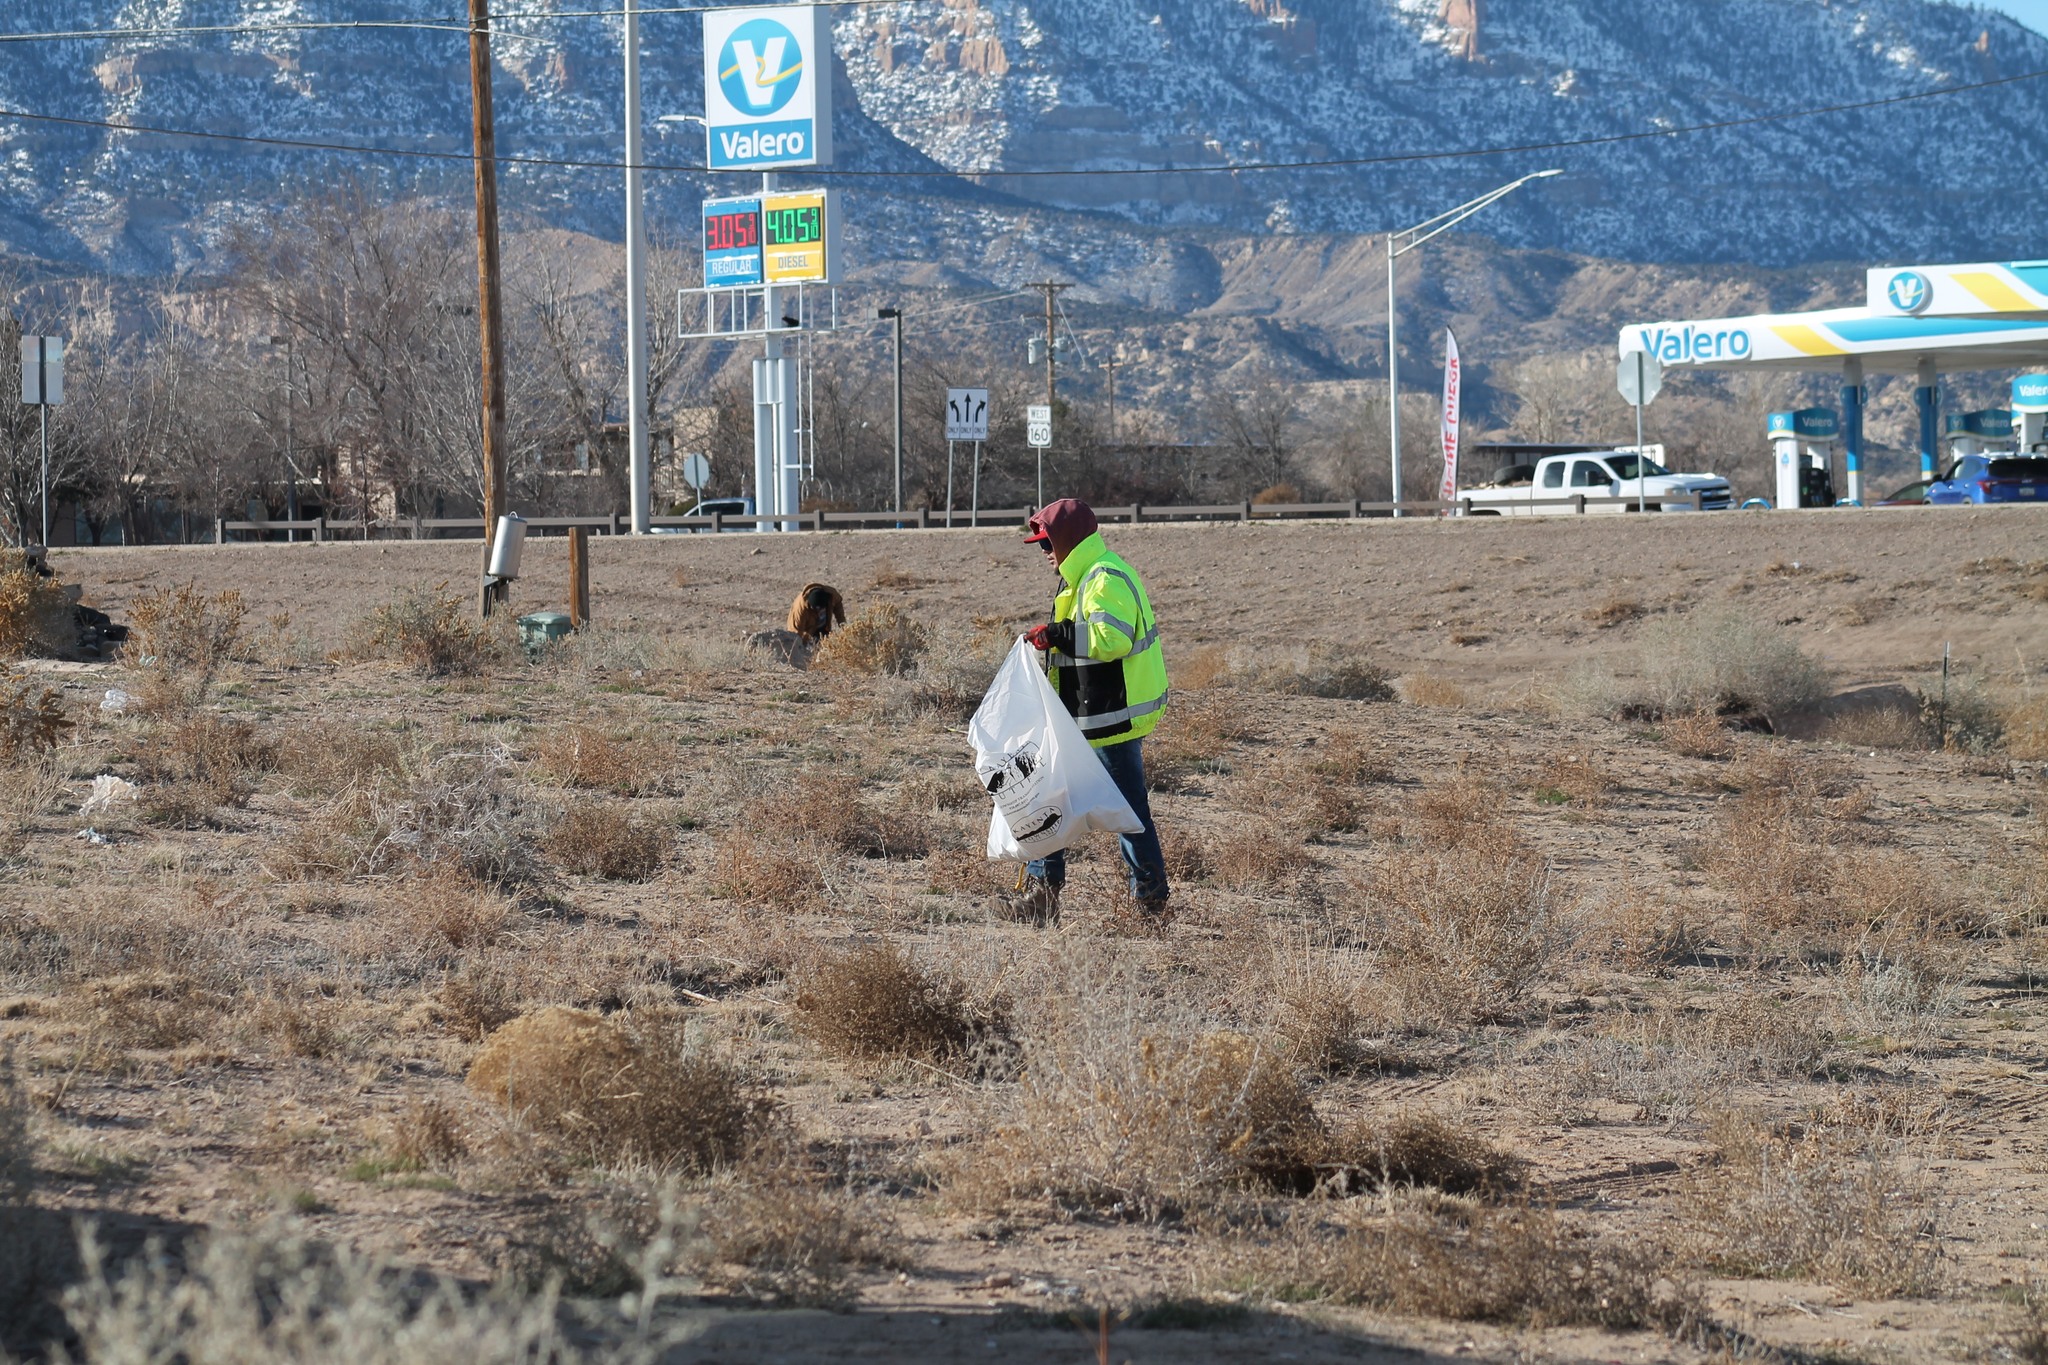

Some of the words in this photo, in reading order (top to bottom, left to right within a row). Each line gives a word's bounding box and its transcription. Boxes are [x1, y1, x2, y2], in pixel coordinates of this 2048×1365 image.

[720, 129, 804, 160] Valero
[708, 213, 747, 250] 3.05
[767, 208, 810, 243] 4.05
[712, 259, 752, 275] REGULAR
[778, 255, 808, 269] DIESEL
[1640, 327, 1749, 361] Valero
[2019, 385, 2048, 396] Valer
[1031, 409, 1047, 419] WEST
[1802, 417, 1833, 427] Valero
[1981, 418, 2009, 428] Valero
[1030, 428, 1048, 441] 160
[1012, 807, 1055, 834] KAYENTA
[1024, 820, 1060, 843] TOWNSHIP
